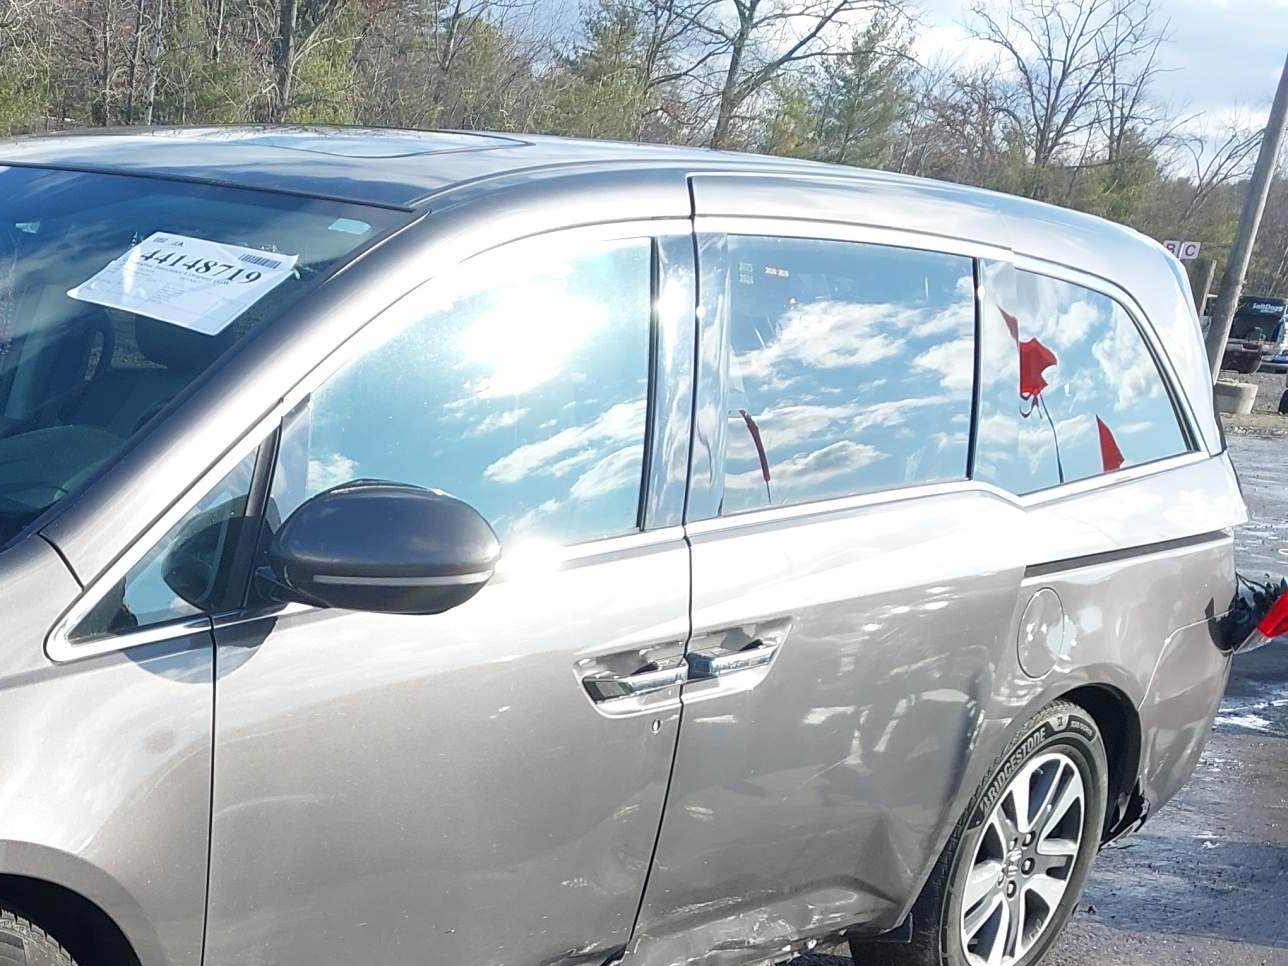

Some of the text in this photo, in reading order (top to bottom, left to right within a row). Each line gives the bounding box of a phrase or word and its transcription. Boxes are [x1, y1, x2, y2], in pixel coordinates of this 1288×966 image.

[141, 249, 262, 284] 44148719
[1185, 244, 1196, 256] C
[979, 727, 1046, 811] BRIDGESTONE
